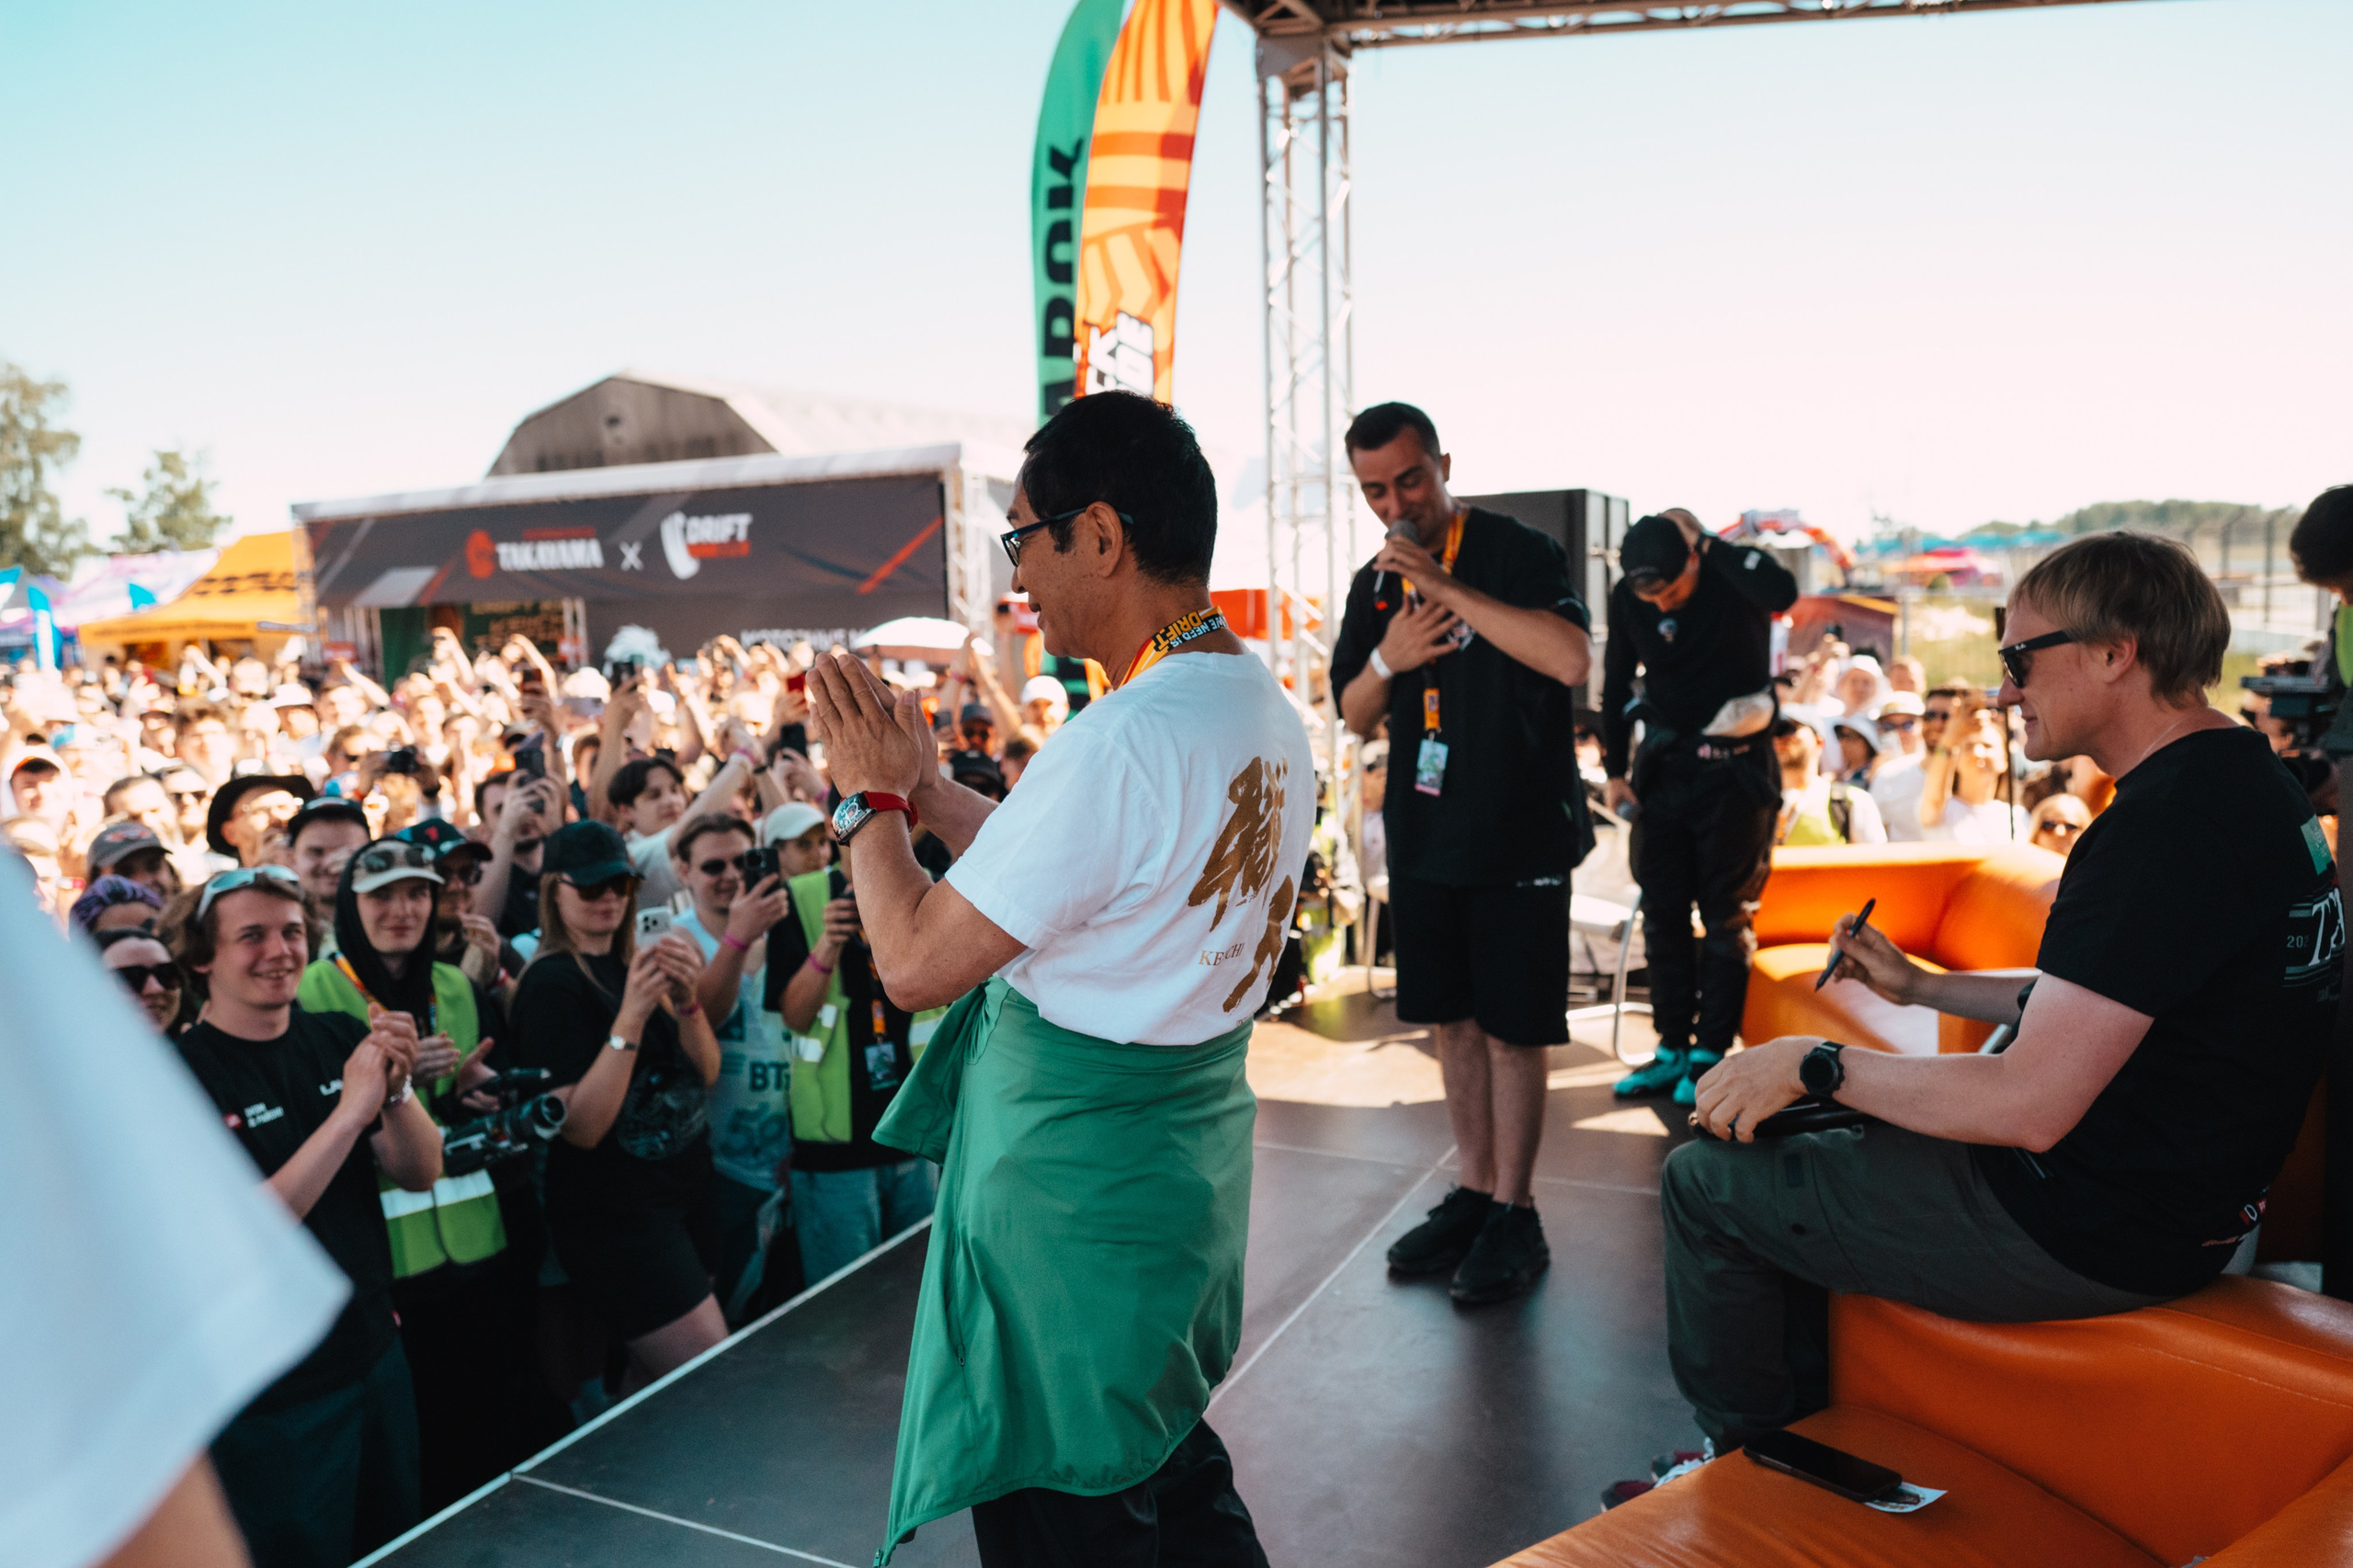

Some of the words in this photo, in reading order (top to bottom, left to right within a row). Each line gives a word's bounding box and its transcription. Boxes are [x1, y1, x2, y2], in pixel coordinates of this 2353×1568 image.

[1155, 610, 1203, 652] DRIFT
[1182, 620, 1211, 642] NEED
[1208, 615, 1229, 630] WE
[1170, 637, 1184, 648] IS
